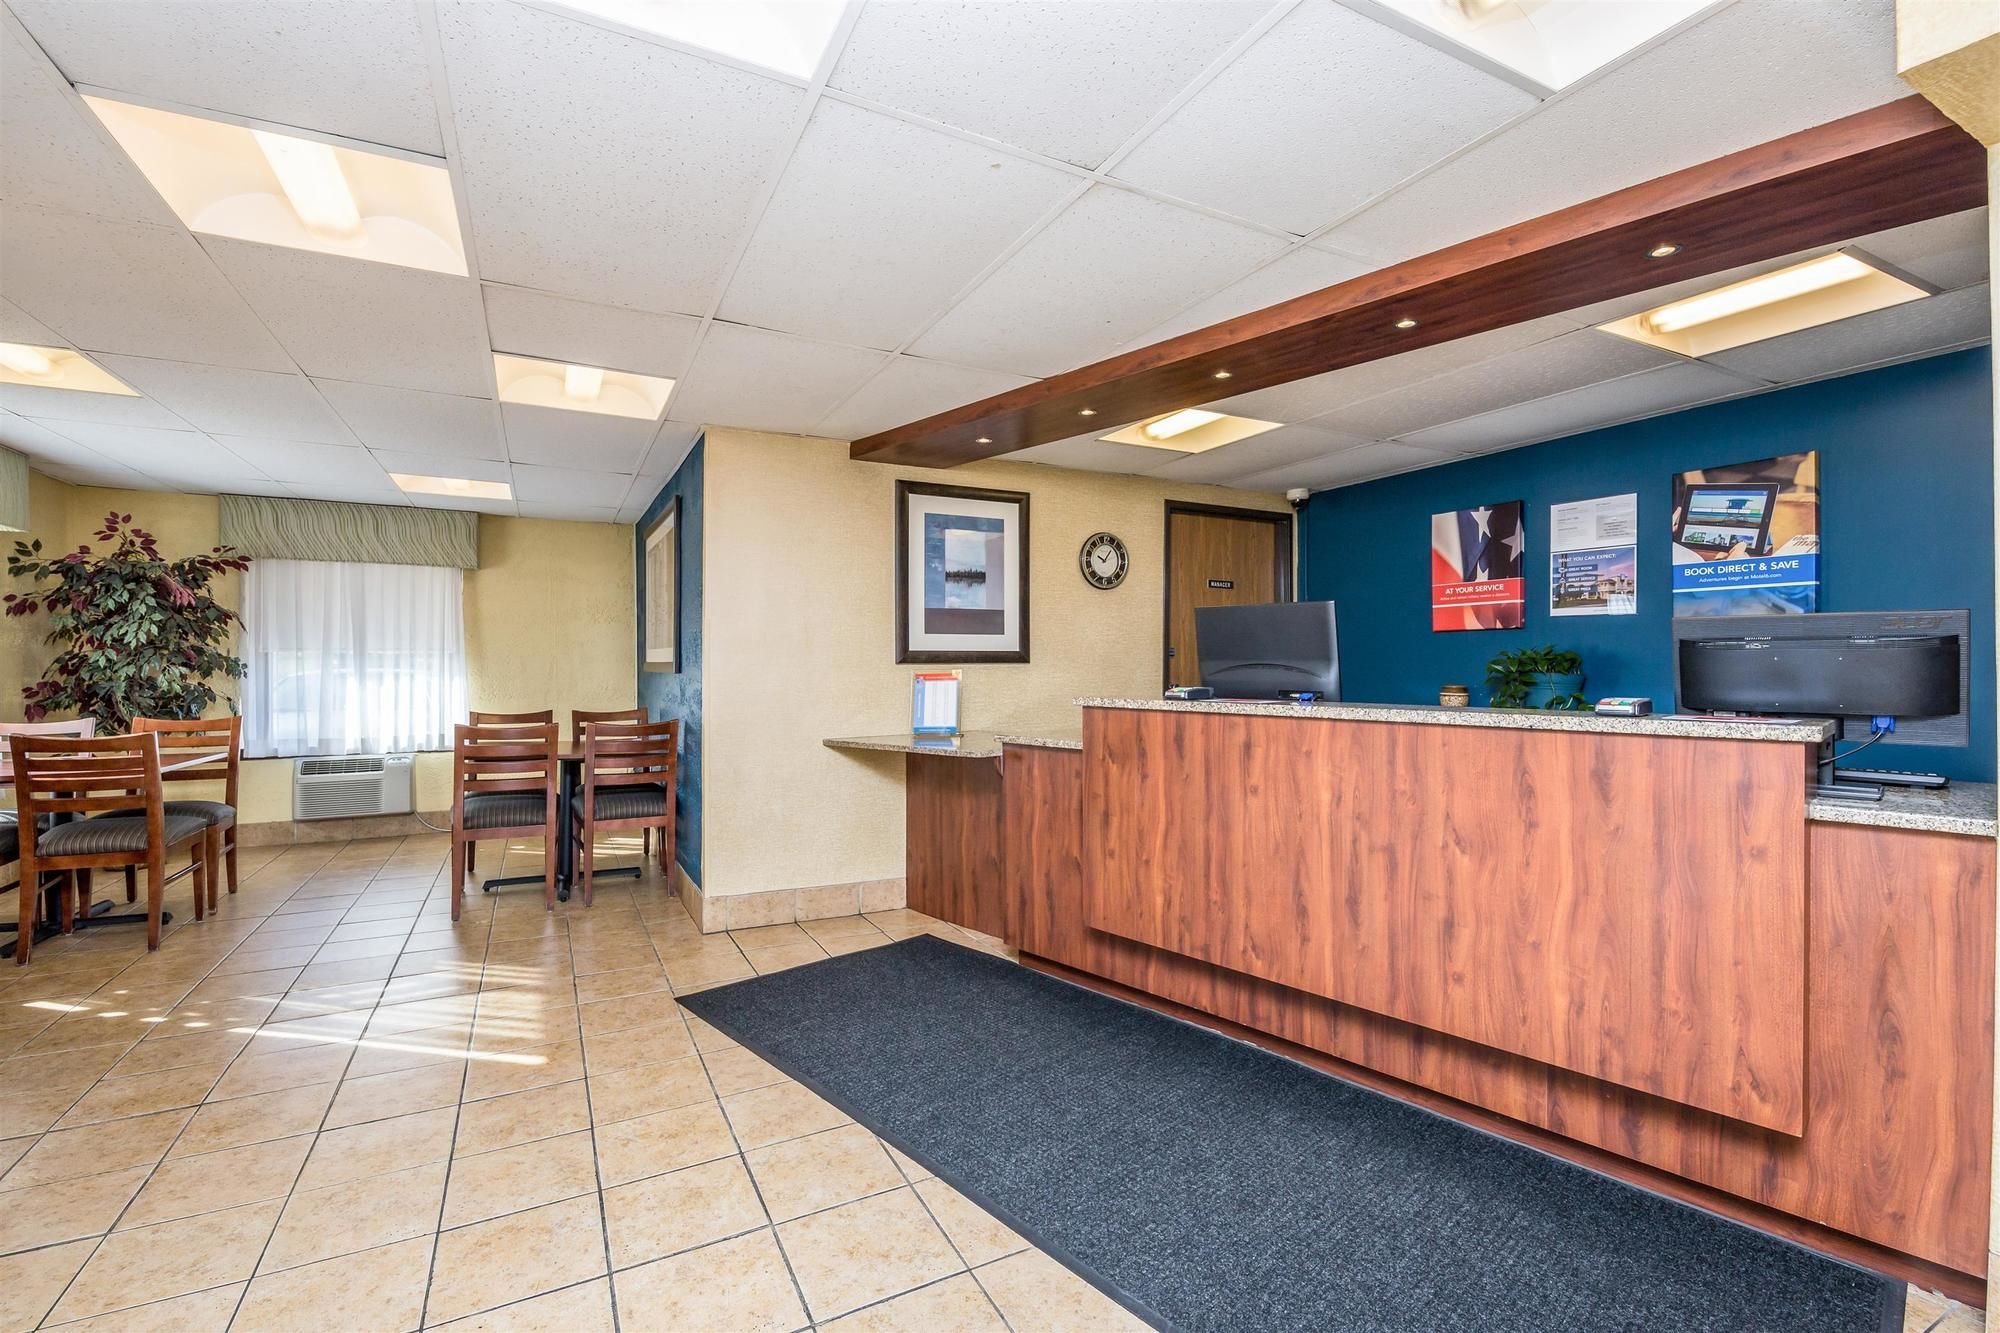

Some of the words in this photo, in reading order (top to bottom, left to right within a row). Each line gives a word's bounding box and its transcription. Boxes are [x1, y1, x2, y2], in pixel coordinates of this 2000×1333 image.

[1684, 566, 1715, 576] BOOK
[1717, 563, 1756, 574] DIRECT
[1759, 562, 1767, 571] &
[1770, 560, 1799, 570] SAVE
[1455, 586, 1474, 594] YOUR
[1475, 584, 1505, 593] SERVICE
